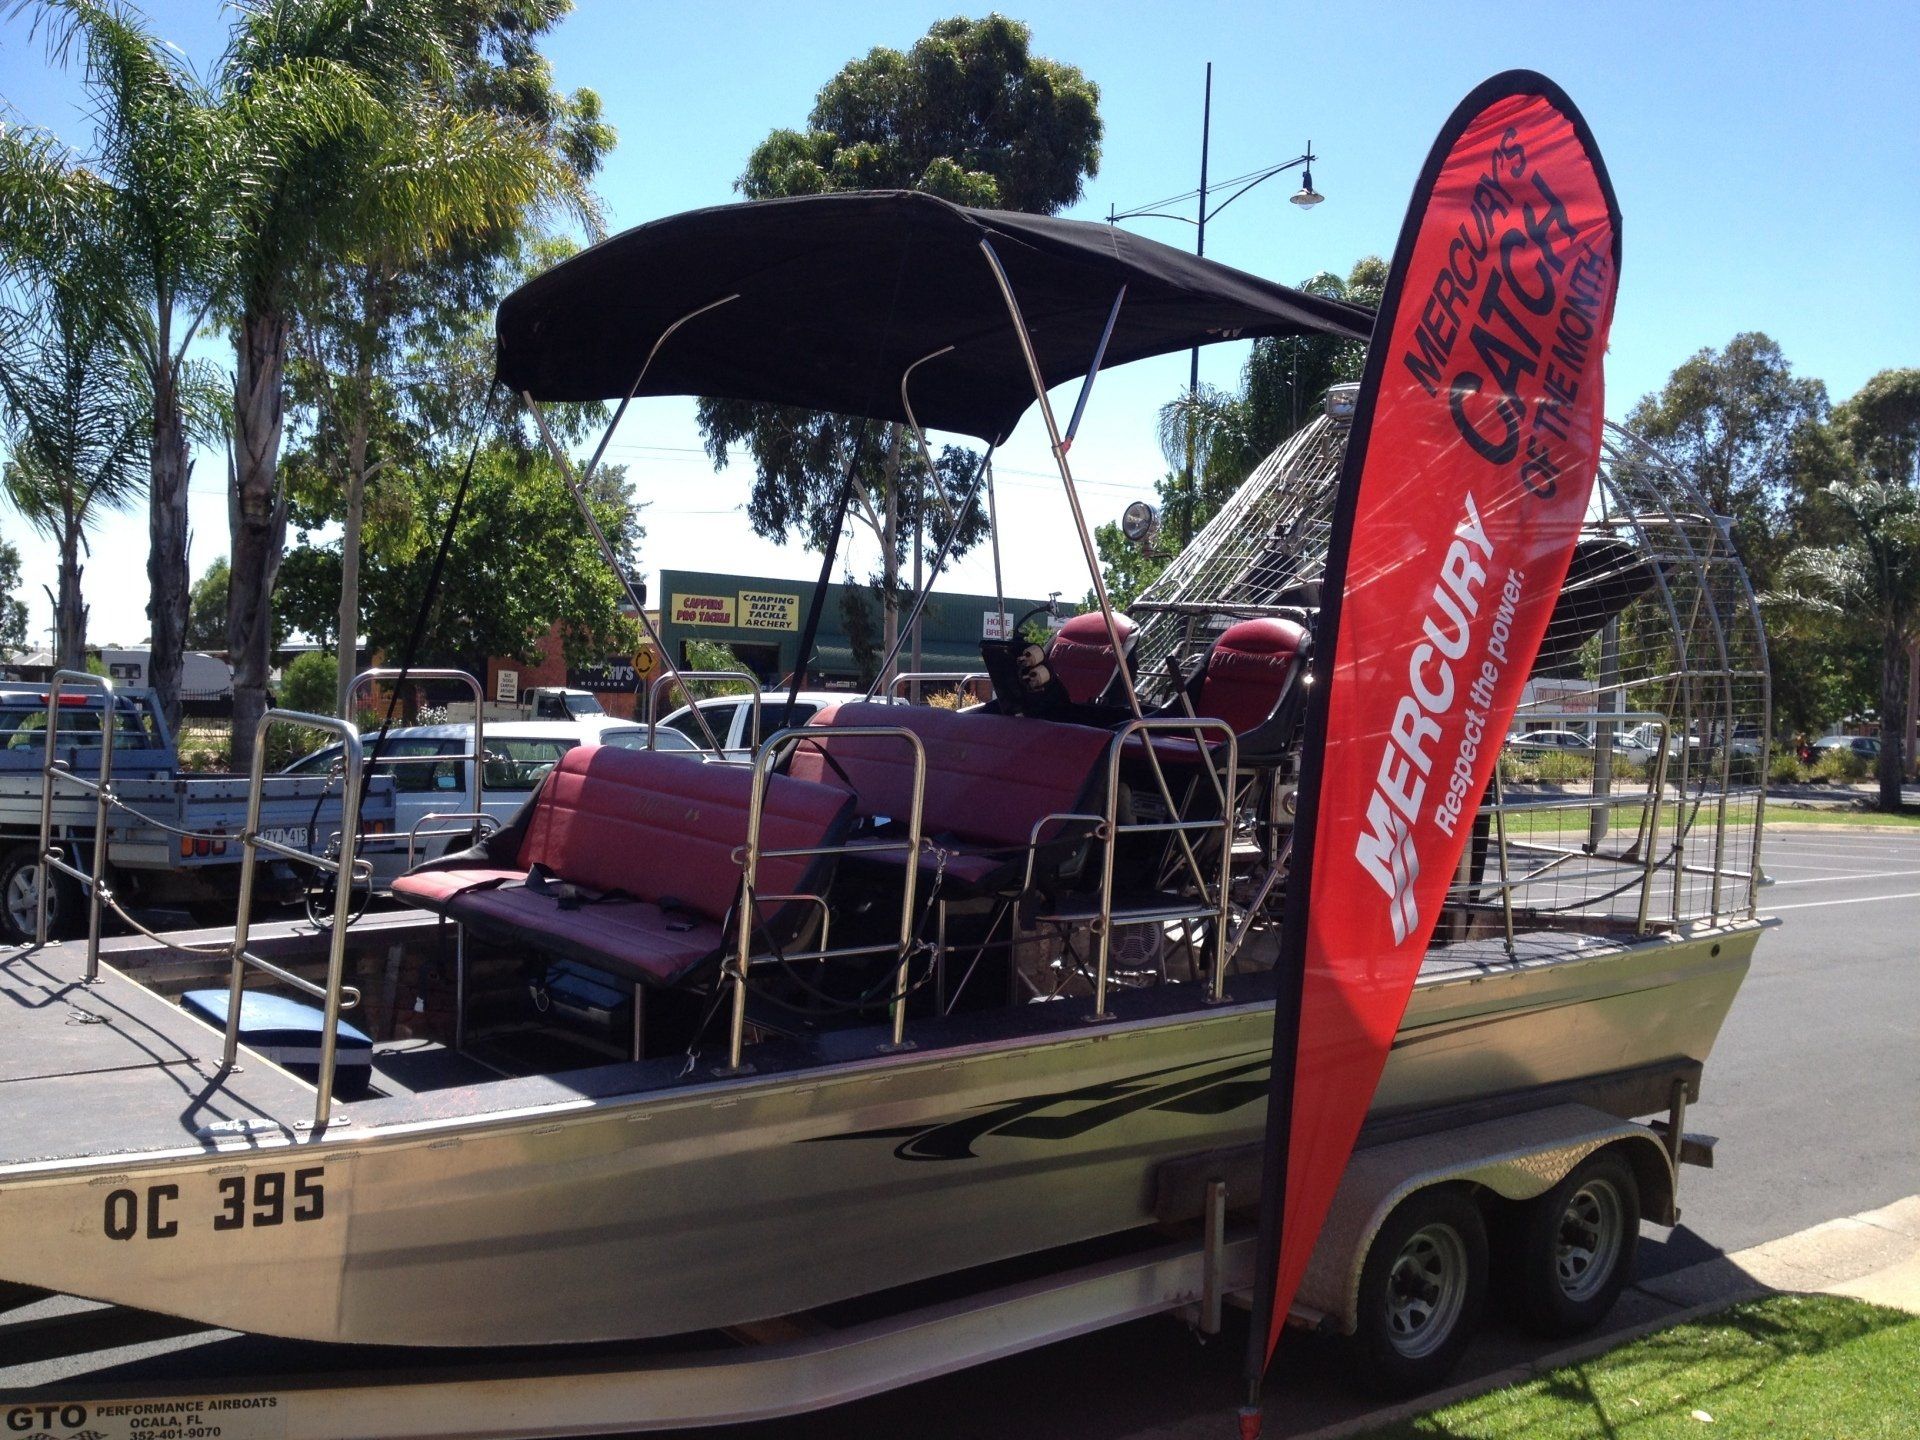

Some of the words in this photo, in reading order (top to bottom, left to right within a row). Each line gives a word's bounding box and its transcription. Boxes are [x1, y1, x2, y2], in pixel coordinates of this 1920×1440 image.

[1403, 126, 1527, 399] MERCURY'S
[1448, 169, 1580, 466] CATCH
[1552, 242, 1606, 375] MONTH
[1533, 361, 1579, 442] THE
[1520, 435, 1562, 500] OF
[743, 594, 795, 605] CAMPING
[751, 602, 775, 611] BAIT
[676, 610, 697, 621] PRO
[698, 611, 731, 624] TACKLE
[745, 619, 793, 629] ARCHERY
[749, 611, 788, 620] TACKLE
[1355, 489, 1495, 900] MERCURY
[1433, 707, 1486, 838] Respect
[1469, 660, 1499, 710] the
[1487, 567, 1526, 664] power.
[103, 1183, 179, 1241] QC
[213, 1166, 325, 1231] 395
[6, 1404, 88, 1432] GTO
[96, 1401, 204, 1417] PERFORMANCE
[208, 1396, 278, 1411] AIRBOATS
[129, 1416, 182, 1429] OCALA,
[186, 1414, 204, 1426] FL
[129, 1426, 222, 1440] 352-401-9070
